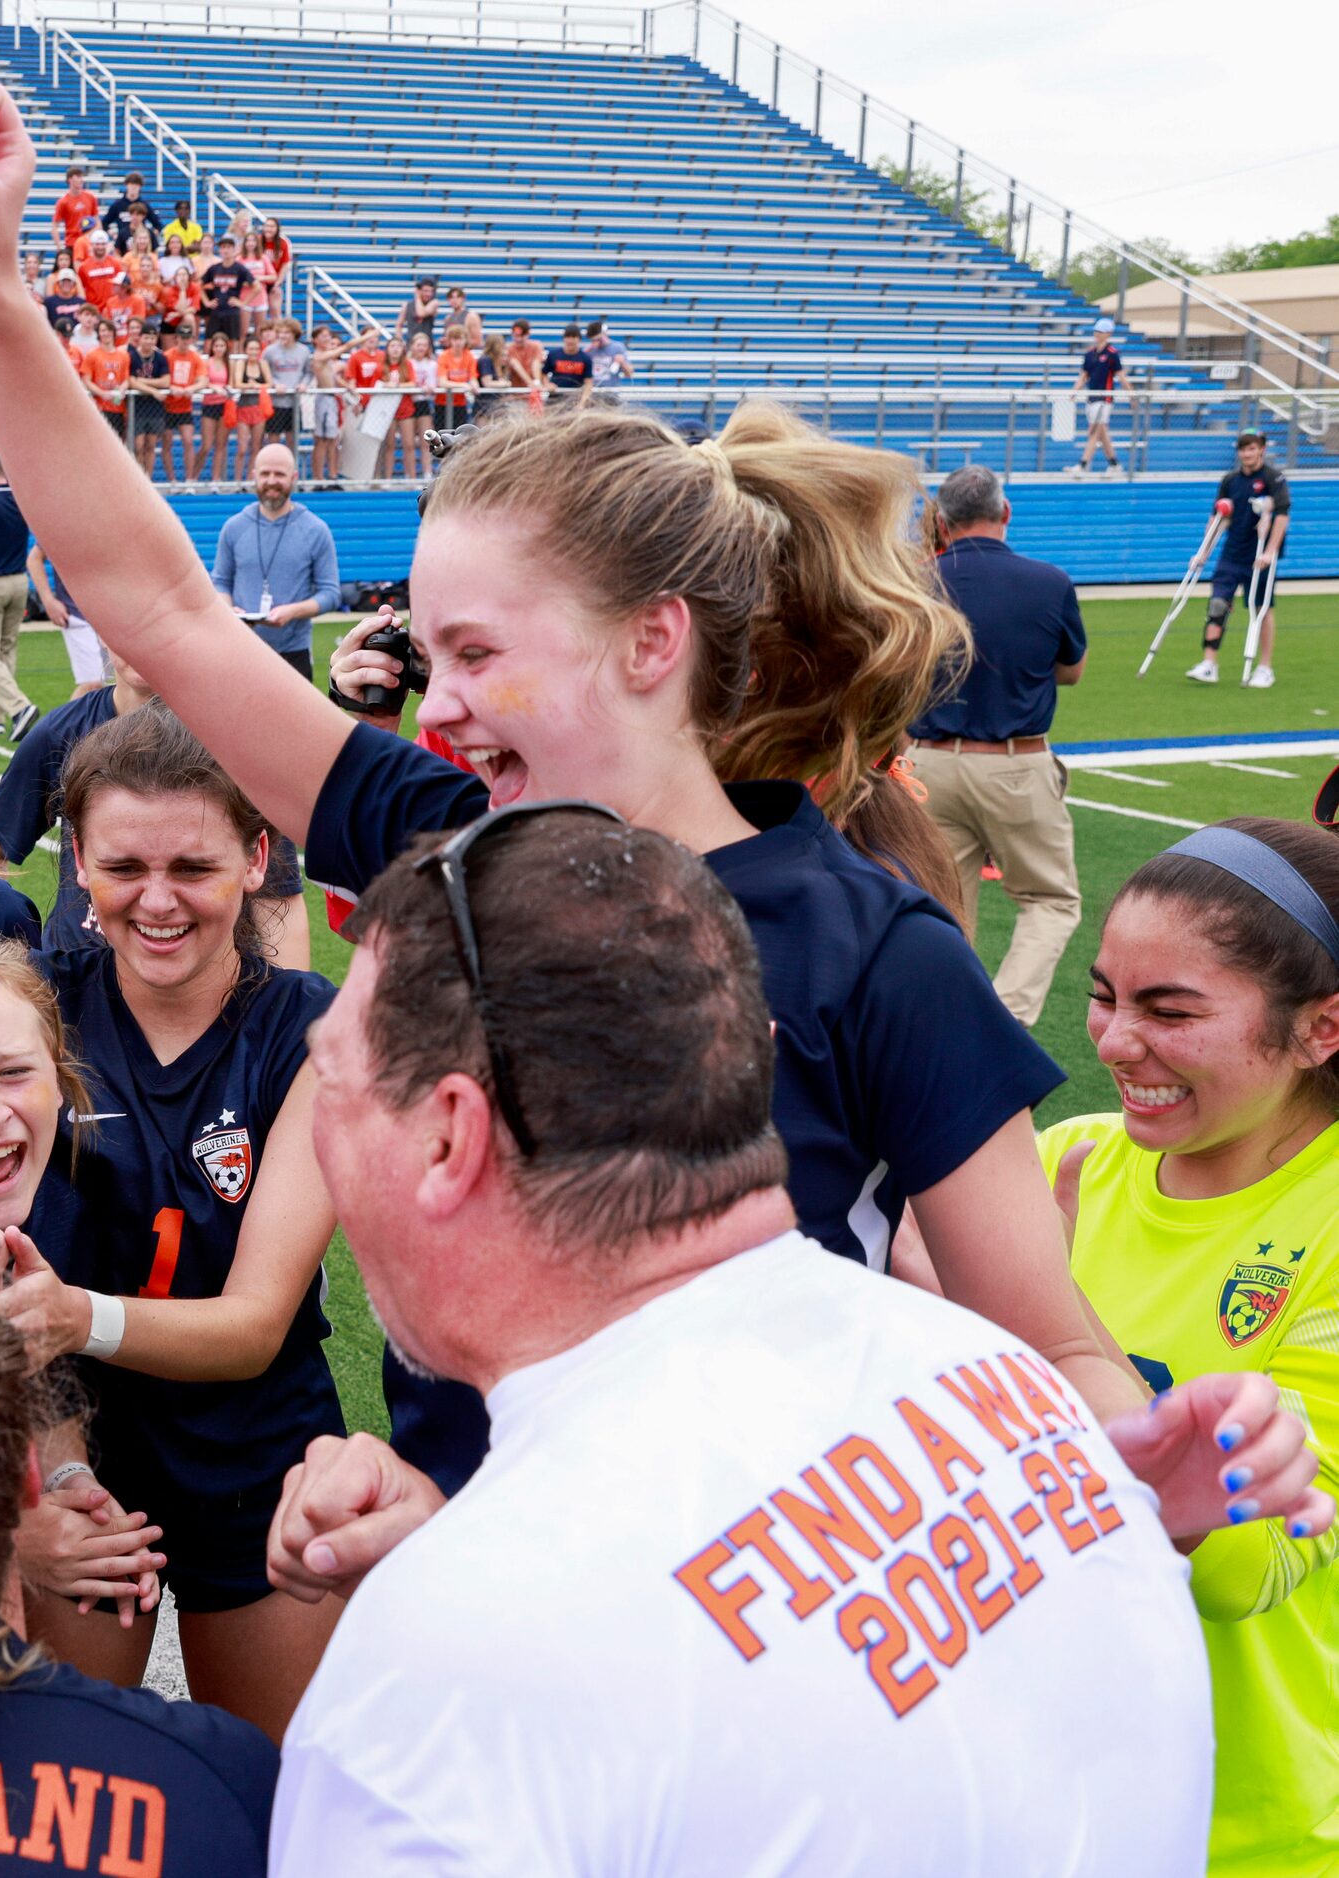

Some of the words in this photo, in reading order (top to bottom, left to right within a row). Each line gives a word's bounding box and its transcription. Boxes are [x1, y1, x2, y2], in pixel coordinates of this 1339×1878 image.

[194, 1133, 246, 1156] WOLVERINES
[138, 1206, 185, 1299] 1
[893, 1397, 985, 1496] A
[935, 1352, 1088, 1454] WAY
[672, 1433, 923, 1663] FIND
[835, 1438, 1125, 1720] 2021-22
